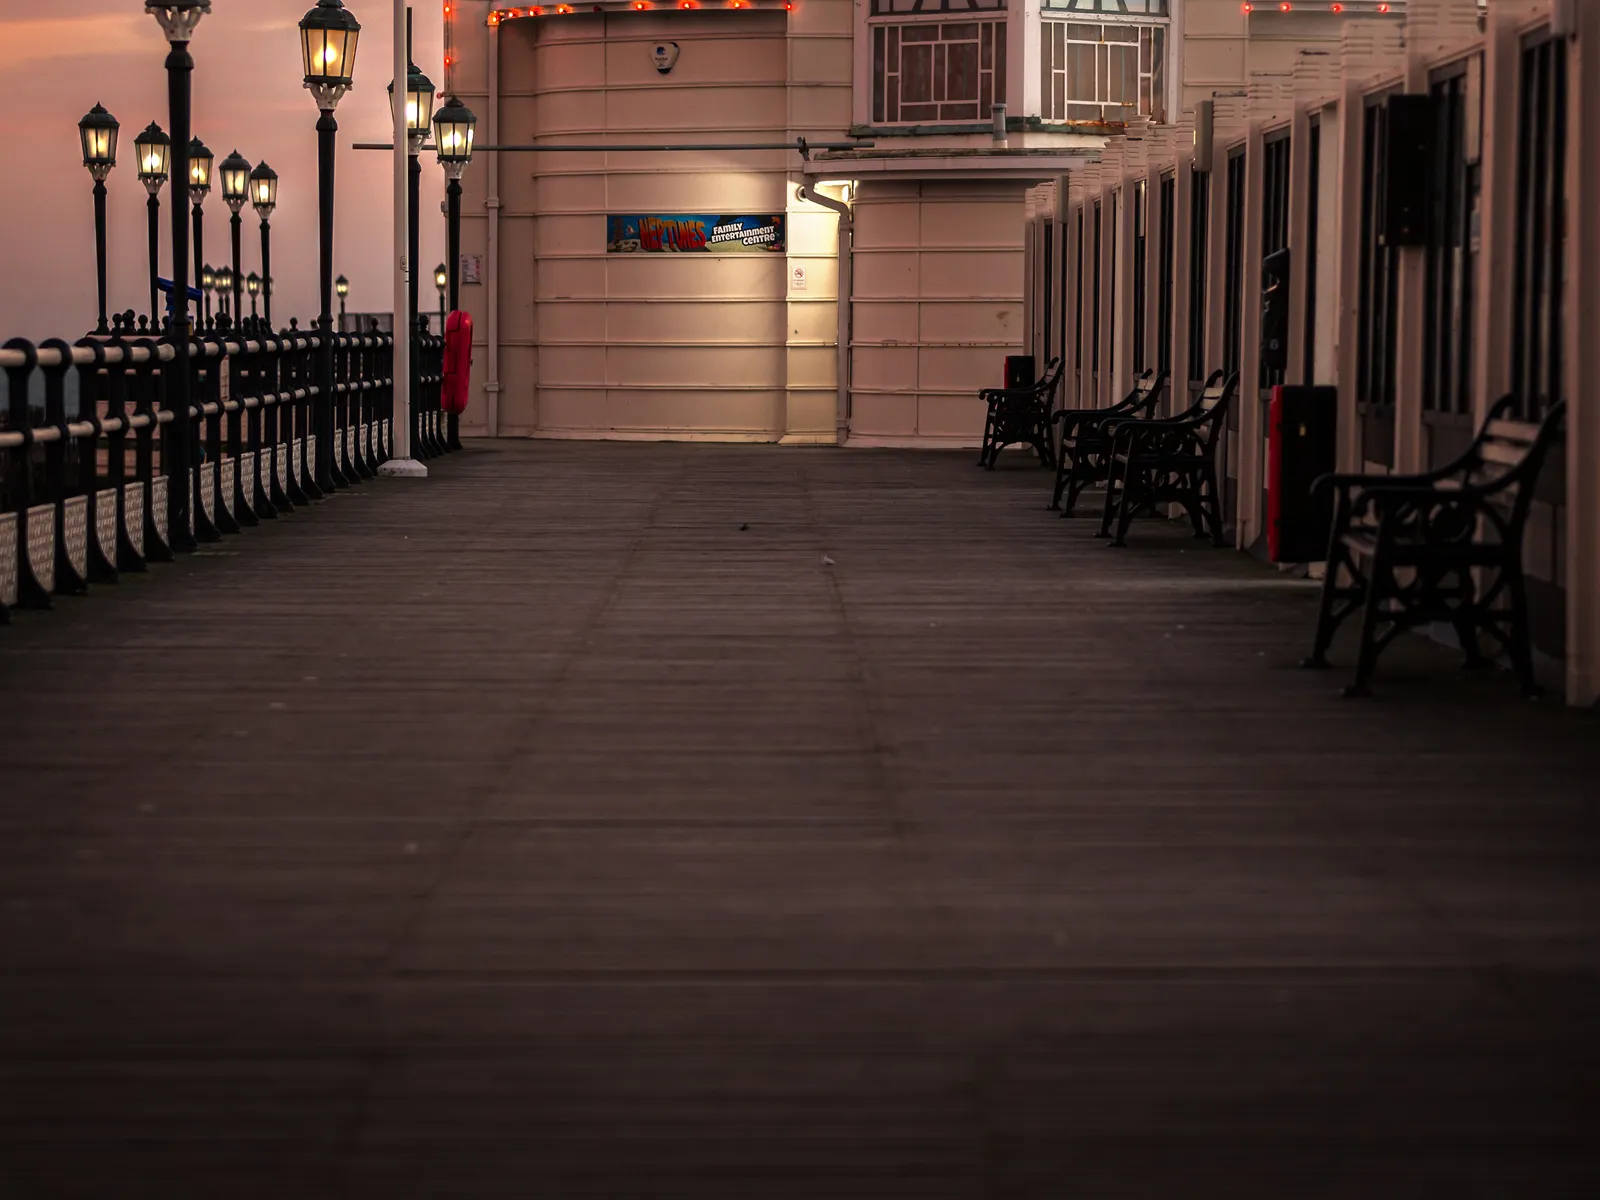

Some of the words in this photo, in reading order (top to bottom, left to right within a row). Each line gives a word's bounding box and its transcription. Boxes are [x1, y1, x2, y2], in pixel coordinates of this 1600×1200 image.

[638, 216, 706, 249] NEPTUNES
[711, 225, 775, 243] ENTERTAINMENT
[713, 222, 743, 235] FAMILY
[743, 232, 776, 245] CENTRE
